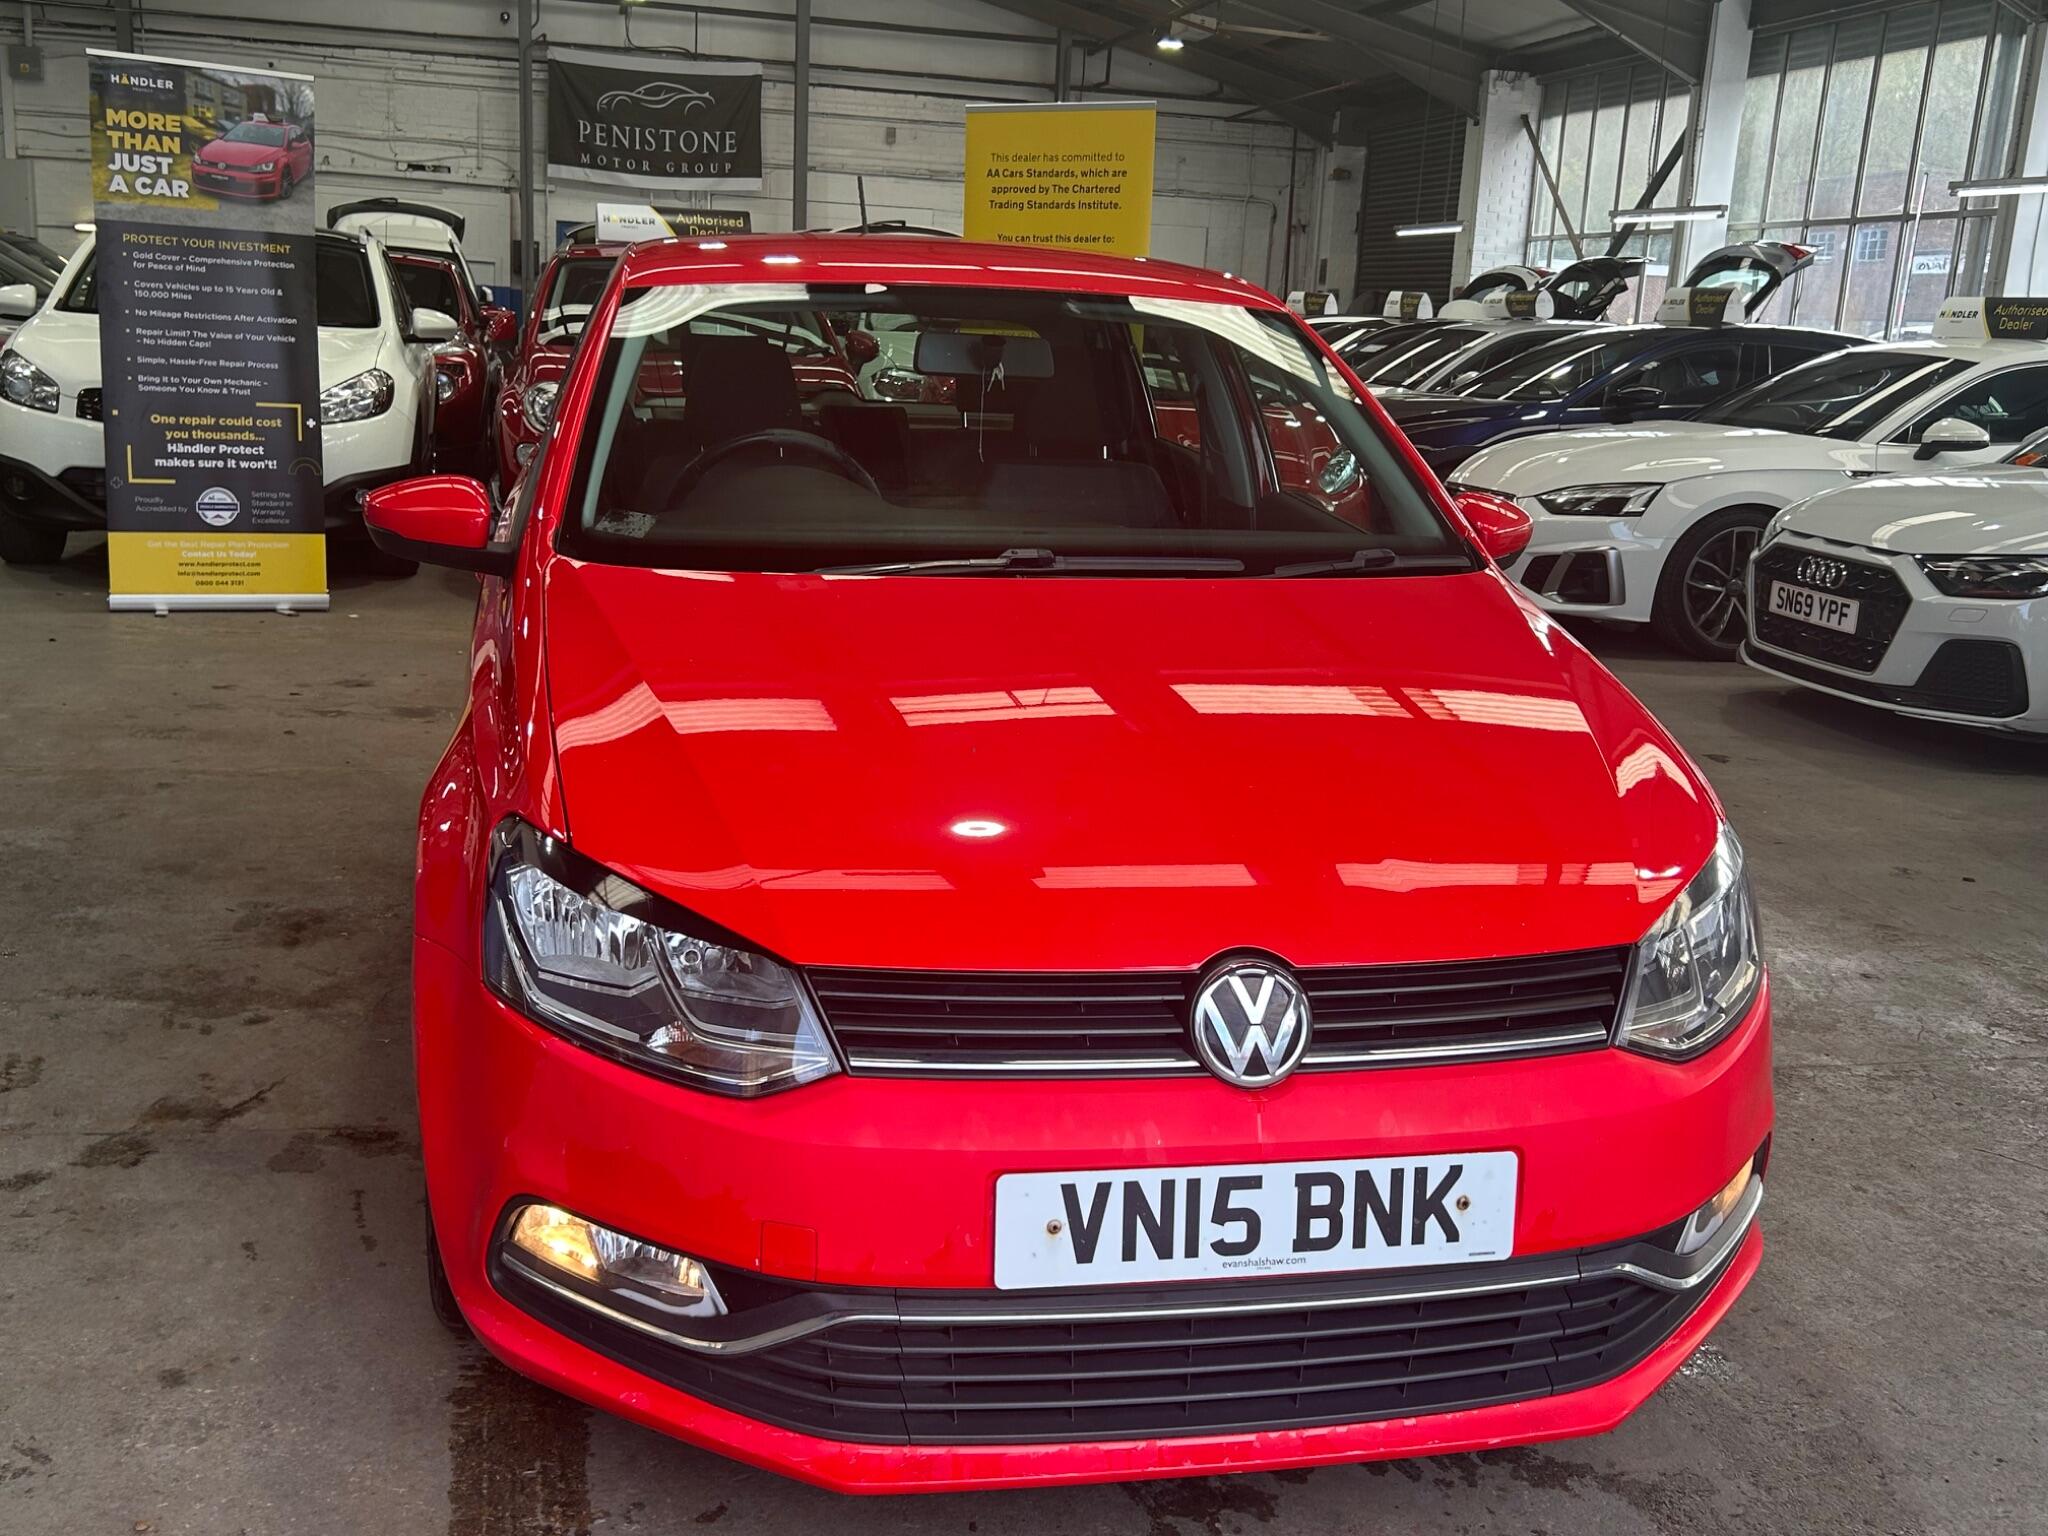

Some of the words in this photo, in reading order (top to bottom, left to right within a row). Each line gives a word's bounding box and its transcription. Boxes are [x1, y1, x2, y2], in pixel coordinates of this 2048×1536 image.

[106, 108, 182, 132] MORE
[106, 130, 180, 154] THAN
[578, 120, 736, 154] PENISTONE
[990, 153, 1009, 162] This
[1012, 152, 1040, 162] dealer
[1043, 153, 1058, 162] has
[1062, 152, 1112, 162] committed
[1115, 153, 1125, 162] to
[108, 152, 173, 175] JUST
[580, 153, 650, 171] MOTOR
[666, 162, 731, 174] GROUP
[986, 169, 1000, 178] AA
[1002, 169, 1023, 178] Cars
[1026, 168, 1078, 179] Standards,
[1080, 168, 1109, 178] which
[1112, 170, 1127, 178] are
[109, 175, 129, 193] A
[135, 176, 189, 198] CAR
[991, 185, 1036, 196] approved
[1038, 184, 1050, 195] by
[1052, 184, 1069, 194] The
[1072, 184, 1120, 194] Chartered
[989, 200, 1024, 211] Trading
[1027, 200, 1076, 209] Standards
[1078, 200, 1122, 209] Institute.
[676, 214, 744, 227] Authorised
[690, 226, 732, 236] Deal
[122, 233, 178, 246] PROTECT
[182, 238, 215, 248] YOUR
[219, 240, 291, 254] INVESTMENT
[998, 234, 1013, 243] You
[1015, 235, 1030, 243] can
[1033, 235, 1053, 243] trust
[1055, 234, 1071, 243] this
[1074, 234, 1100, 243] dealer
[1103, 235, 1115, 243] to:
[133, 251, 153, 260] Gold
[155, 253, 180, 262] Cover
[189, 255, 252, 267] Comprehensive
[254, 259, 295, 269] Protection
[133, 261, 145, 269] for
[175, 264, 183, 272] of
[186, 264, 206, 273] Mind
[134, 280, 164, 288] Covers
[166, 282, 200, 291] Vehicles
[202, 285, 212, 294] up
[214, 285, 223, 293] to
[225, 285, 234, 293] 15
[236, 286, 258, 295] Years
[260, 287, 275, 296] Old
[172, 292, 192, 300] Miles
[150, 310, 182, 320] Mileage
[184, 312, 231, 321] Restrictions
[234, 314, 254, 322] After
[257, 315, 297, 325] Activation
[1999, 318, 2034, 330] Dealer
[136, 328, 163, 337] Repair
[166, 329, 191, 337] Limit?
[193, 330, 208, 338] The
[210, 331, 232, 339] Value
[235, 332, 244, 340] of
[245, 333, 264, 341] Your
[266, 334, 296, 343] Vehicle
[143, 338, 156, 346] No
[157, 338, 187, 347] Hidden
[189, 340, 212, 349] Caps!
[170, 357, 217, 367] Hassle-Free
[219, 360, 245, 369] Repair
[248, 361, 278, 370] Process
[138, 375, 160, 384] Bring
[170, 376, 179, 384] to
[182, 377, 201, 385] Your
[203, 378, 222, 386] Own
[224, 378, 262, 387] Mechanic
[138, 385, 177, 393] Someone
[179, 386, 196, 394] You
[230, 388, 251, 396] Trust
[150, 414, 175, 424] One
[180, 414, 216, 428] repair
[219, 416, 252, 427] could
[256, 418, 282, 428] cost
[165, 430, 188, 441] you
[167, 443, 216, 454] Händler
[219, 444, 264, 455] Protect
[155, 458, 195, 468] makes
[198, 460, 224, 468] sure
[227, 459, 236, 468] it
[1776, 587, 1813, 617] SN69
[1819, 597, 1850, 626] YPF
[1061, 1174, 1262, 1264] VN15
[1292, 1164, 1463, 1252] BNK
[1222, 1257, 1306, 1268] evanshalshaw.com
